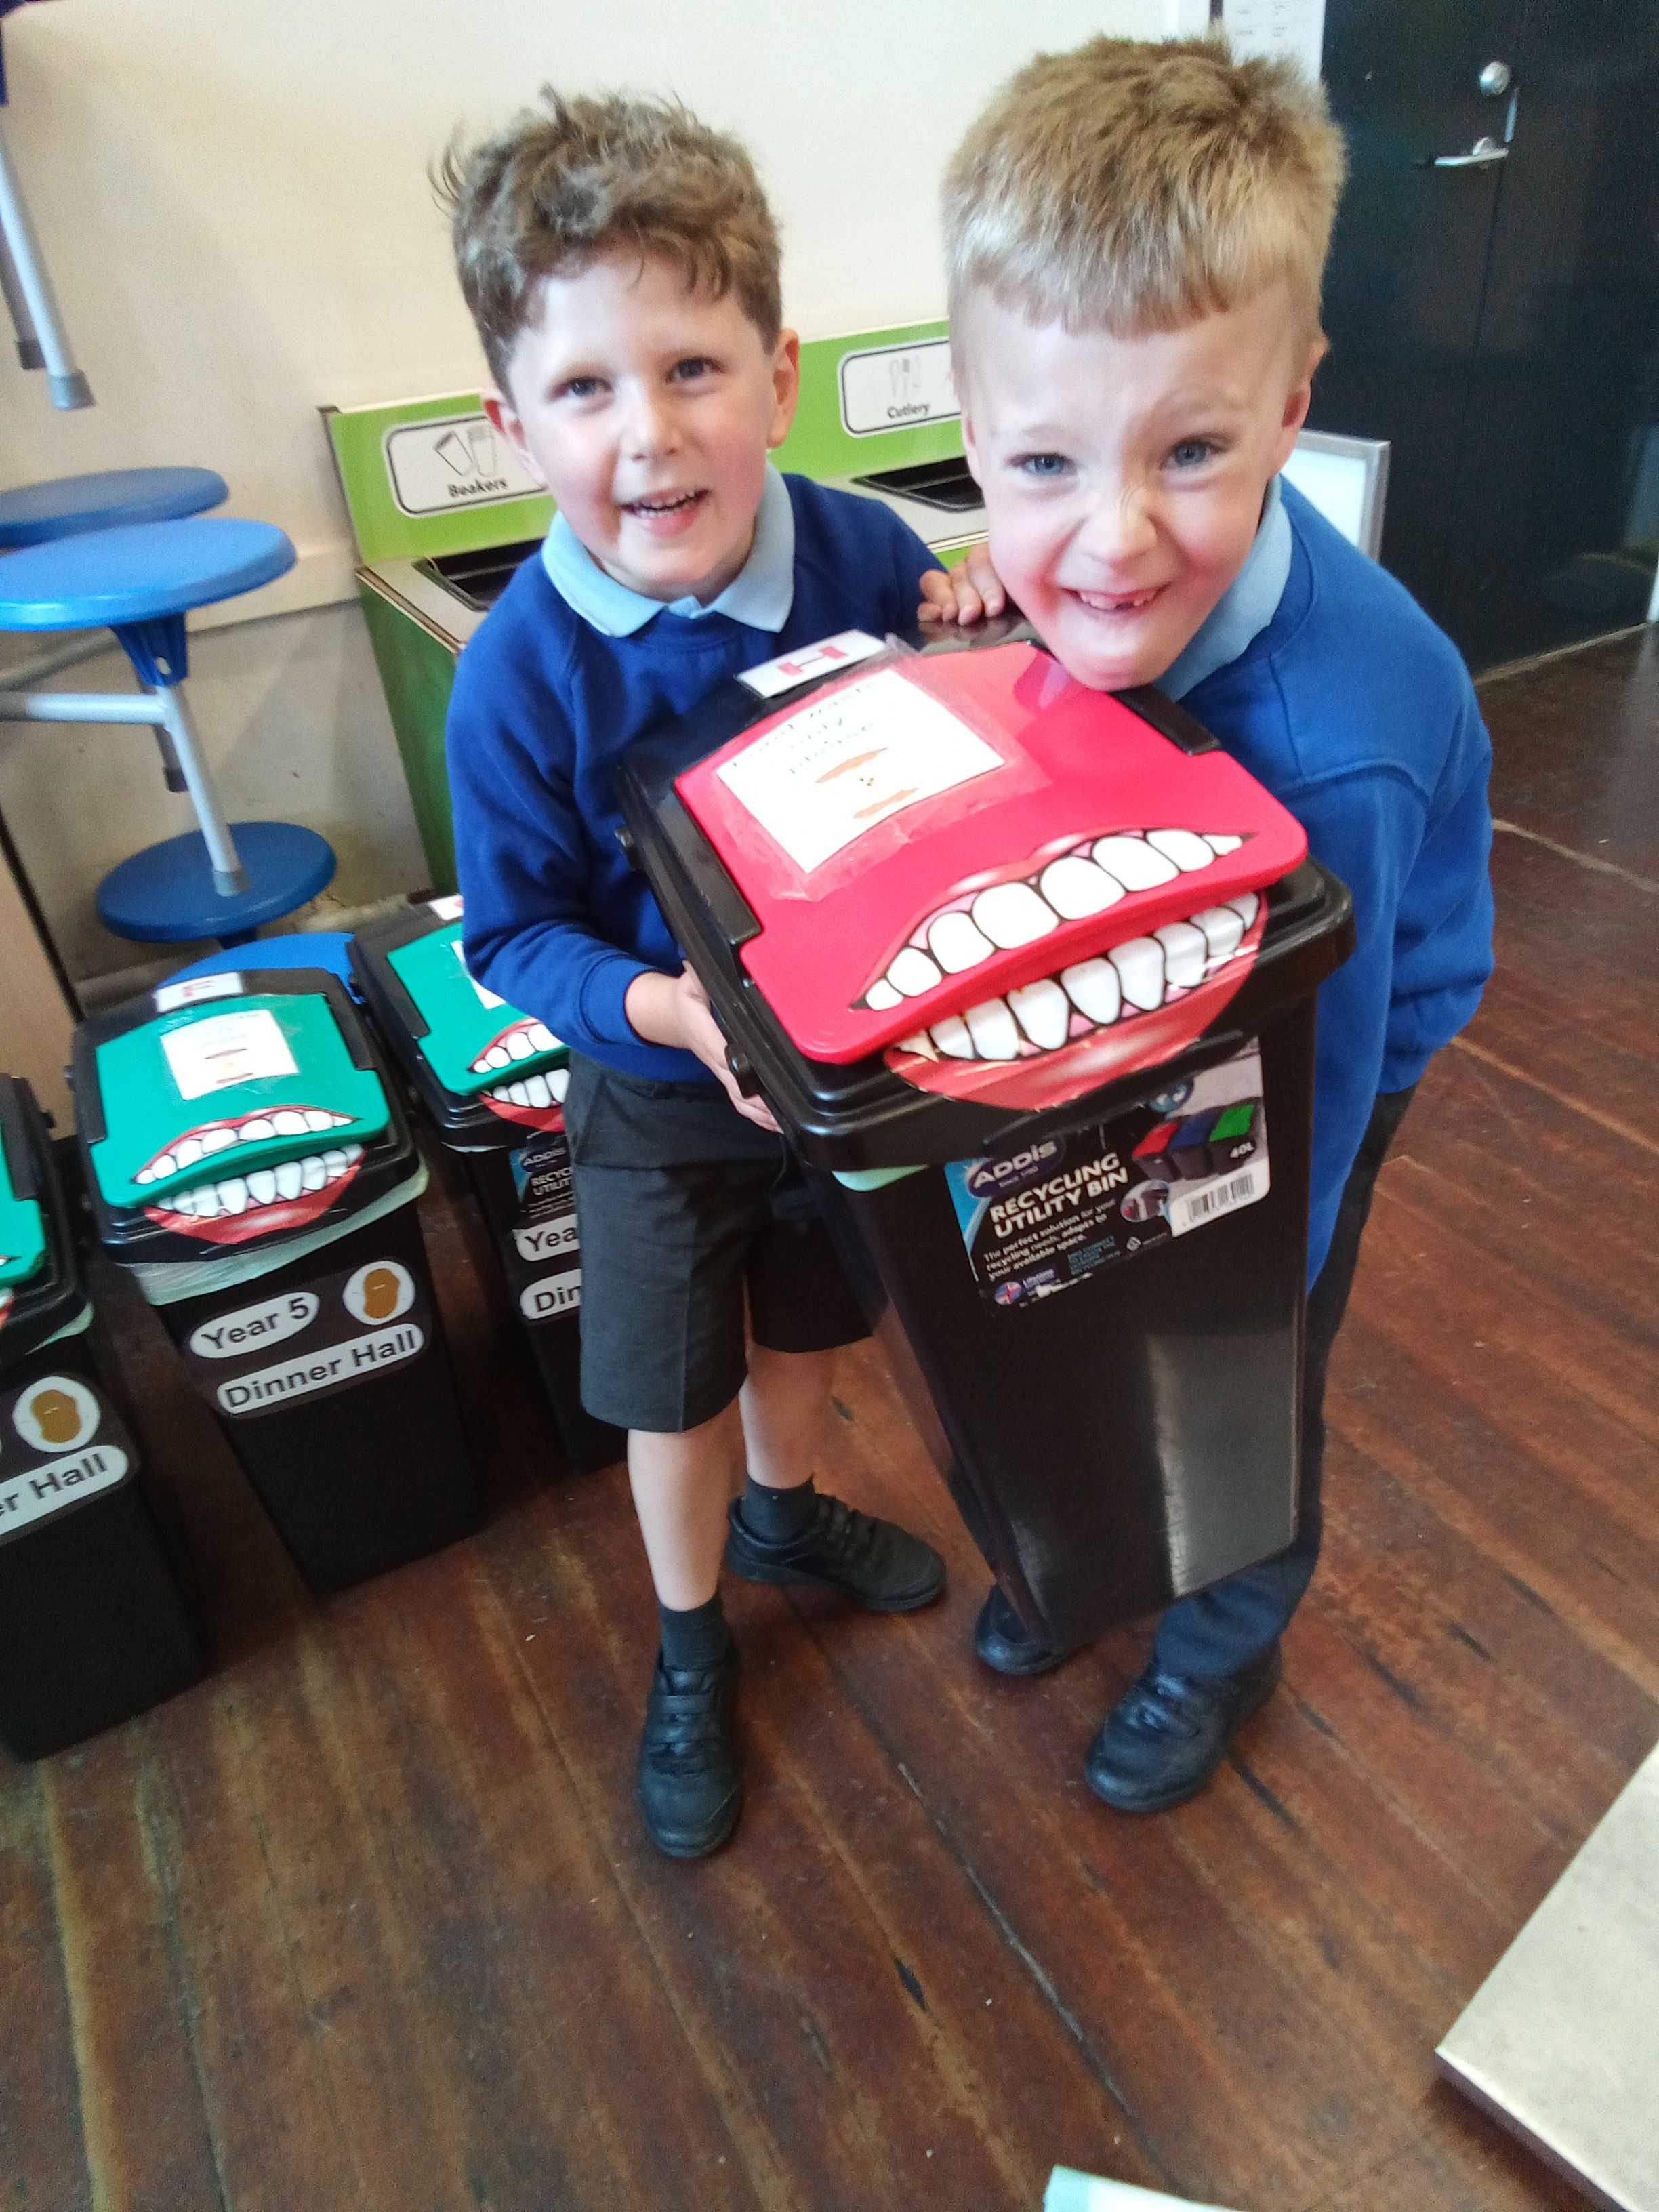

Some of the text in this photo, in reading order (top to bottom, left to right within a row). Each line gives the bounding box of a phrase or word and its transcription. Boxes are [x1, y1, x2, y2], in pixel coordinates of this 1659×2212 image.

[887, 402, 930, 419] Cutlery
[447, 478, 507, 498] Beakers
[531, 1166, 572, 1187] RECYC
[533, 1177, 571, 1196] UTILIT
[989, 1152, 1120, 1223] RECYCLING
[994, 1187, 1082, 1238] UTILITY
[1086, 1166, 1128, 1198] BIN
[524, 1227, 577, 1252] Yea
[1039, 1215, 1080, 1238] solution
[534, 1285, 581, 1312] Din
[201, 1296, 309, 1349] Year 5
[225, 1330, 416, 1408] Dinner Hall
[28, 1453, 108, 1500] Hall
